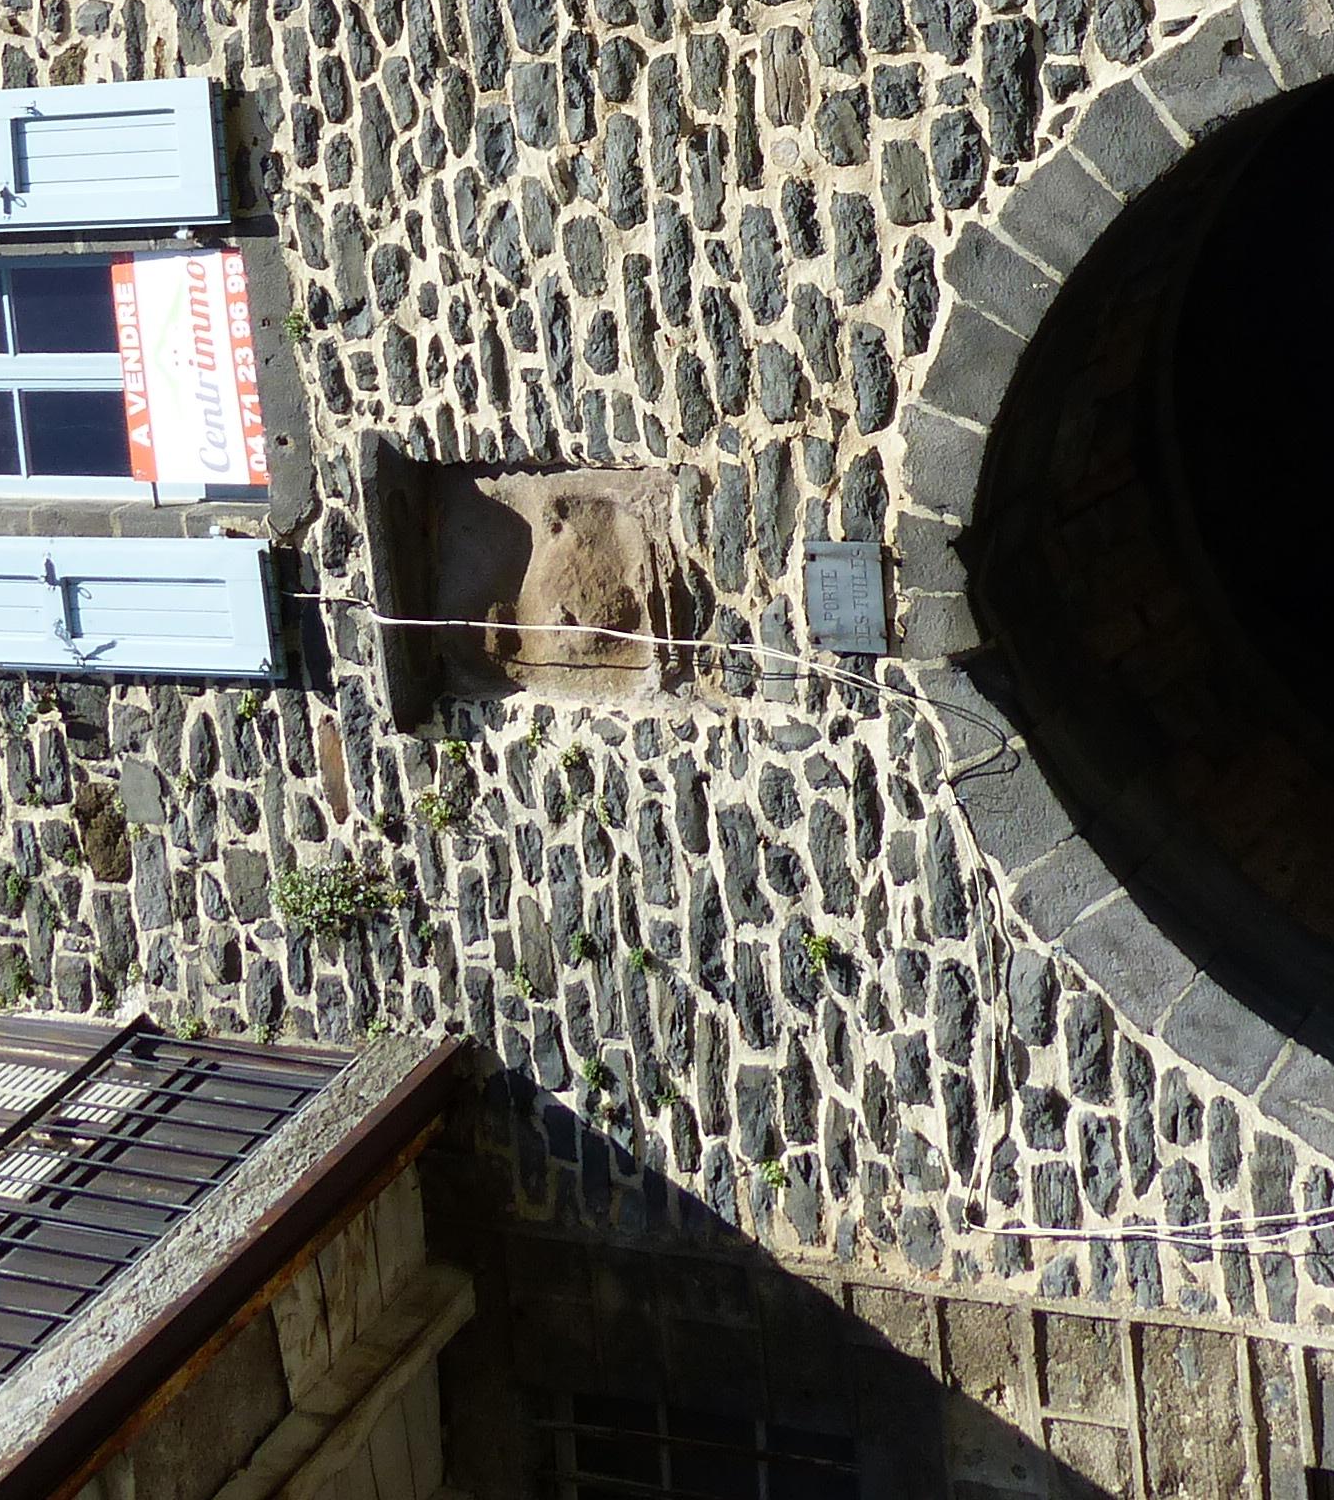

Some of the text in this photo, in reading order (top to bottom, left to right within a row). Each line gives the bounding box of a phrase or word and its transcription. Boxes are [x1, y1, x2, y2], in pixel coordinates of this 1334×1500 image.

[116, 282, 152, 447] A VENDRE
[185, 258, 231, 473] Centrimmo
[225, 257, 267, 472] 04 71 23 96 99
[820, 569, 840, 621] PORTE
[850, 549, 872, 645] DES TUILES
